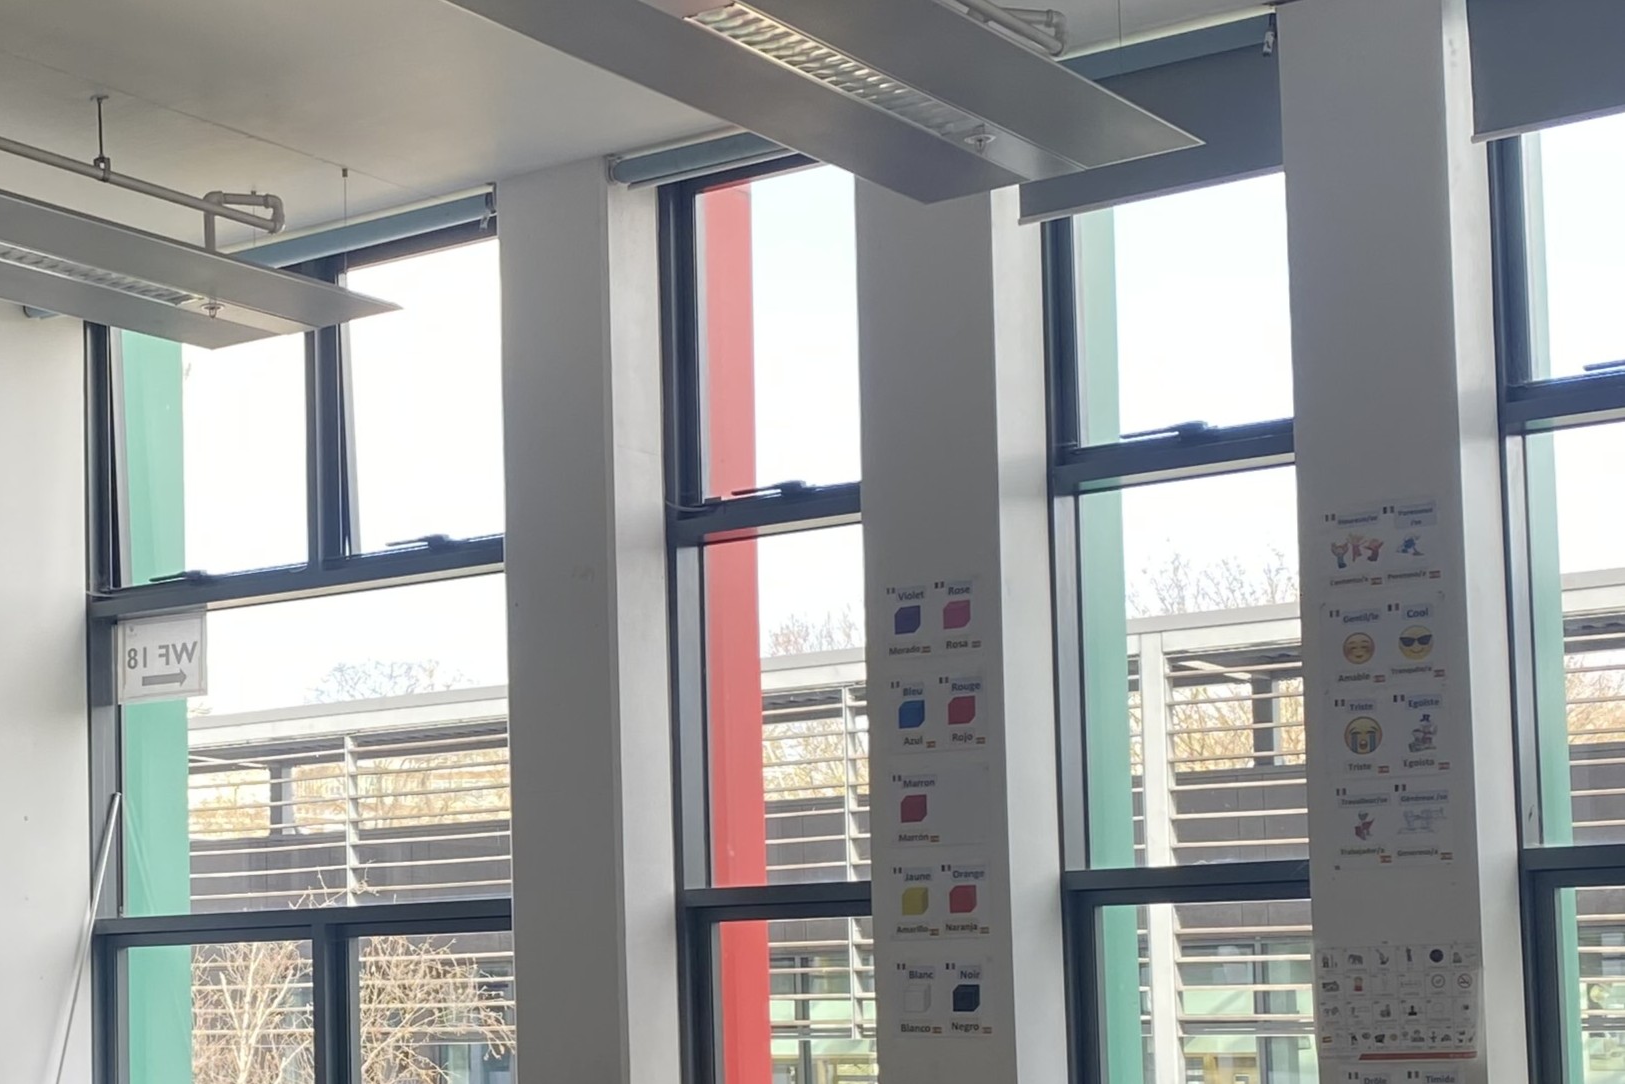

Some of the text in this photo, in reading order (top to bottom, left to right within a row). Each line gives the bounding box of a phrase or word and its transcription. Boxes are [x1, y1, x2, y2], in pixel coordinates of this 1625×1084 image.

[948, 586, 970, 595] Rose
[898, 592, 924, 601] Violet
[1407, 608, 1428, 618] Cool
[946, 641, 968, 649] Rosa
[889, 646, 920, 656] Morado
[951, 682, 981, 692] Rouge
[903, 688, 923, 697] Bleu
[904, 737, 923, 745] Azul
[952, 733, 973, 744] Rojo
[903, 779, 935, 788] Marron
[904, 872, 931, 881] Jaune
[952, 870, 984, 879] Orange
[946, 923, 978, 933] Naranja
[909, 970, 934, 979] Blanc
[960, 970, 980, 979] Noir
[900, 1023, 931, 1032] Blanco
[951, 1022, 980, 1032] Negro
[1426, 1075, 1456, 1083] Timide
